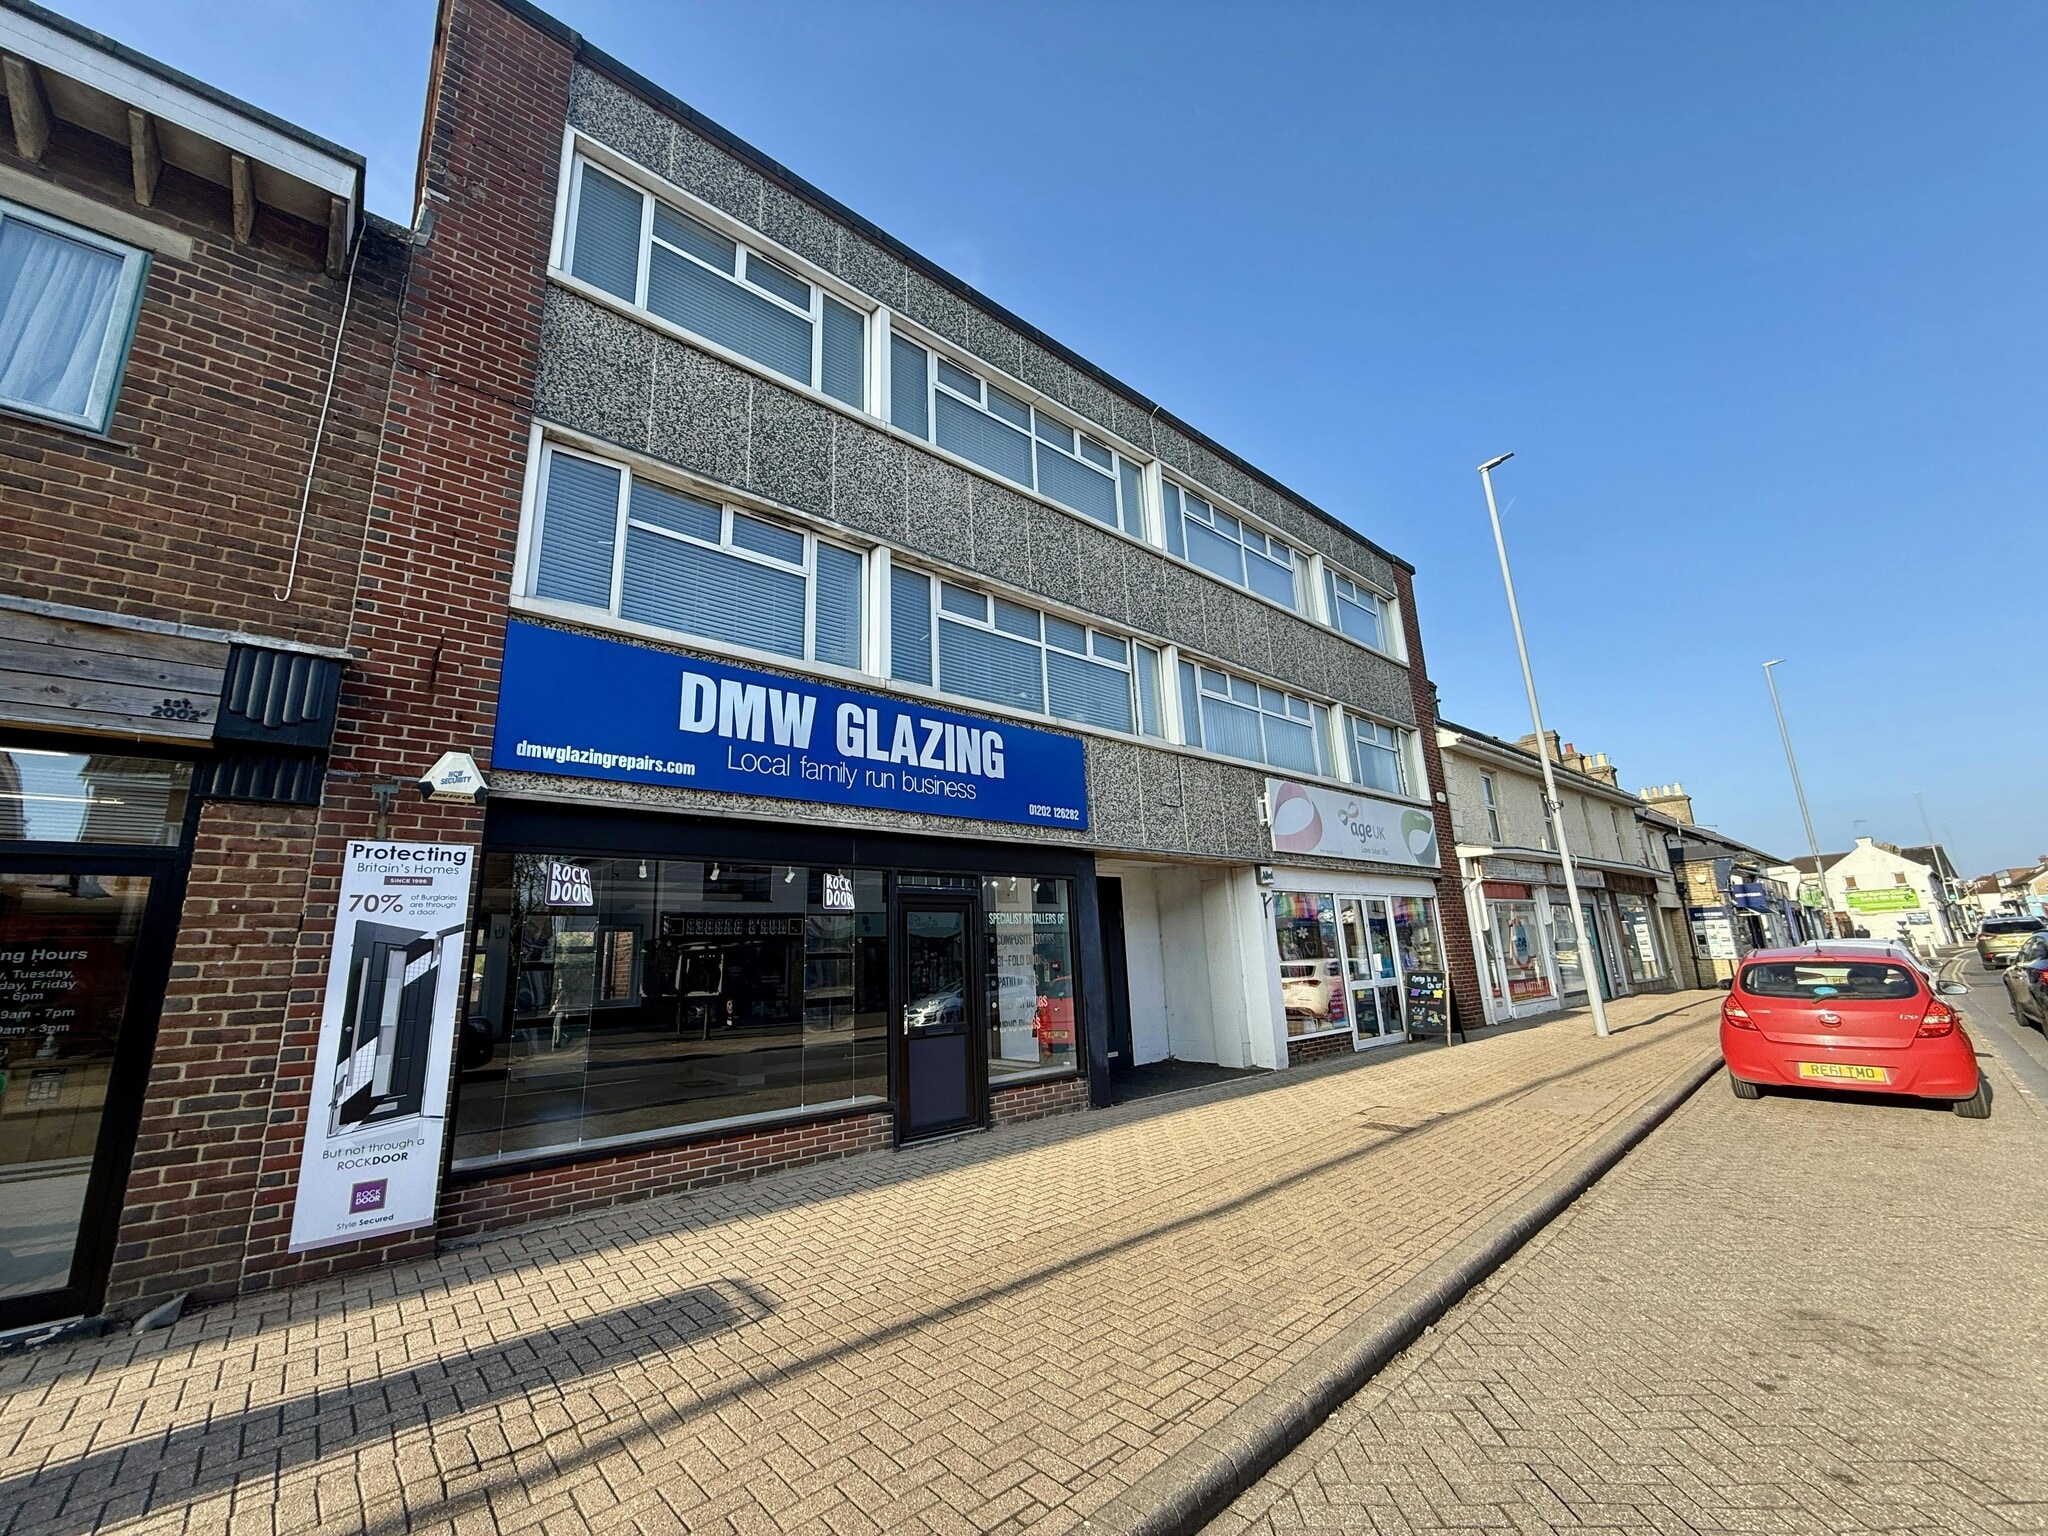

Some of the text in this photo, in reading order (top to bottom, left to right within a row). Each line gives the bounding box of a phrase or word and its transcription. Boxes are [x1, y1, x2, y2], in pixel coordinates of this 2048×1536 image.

[151, 705, 199, 721] 2002
[679, 671, 1005, 779] DMW GLAZING
[516, 740, 696, 776] dmwglazingrepairs.com
[728, 745, 977, 800] Local family run business
[440, 776, 472, 785] SECURITY
[1029, 804, 1079, 820] 01202 126282
[352, 844, 467, 866] Protecting
[357, 862, 459, 875] Britain's Homes
[552, 863, 589, 884] ROCK
[826, 874, 851, 892] ROCK
[550, 880, 591, 902] DOOR
[348, 894, 403, 913] 70%
[421, 894, 458, 904] Burglaries
[826, 889, 853, 907] DOOR
[426, 901, 456, 909] through
[989, 912, 1065, 924] SPECIALIST INSTALLERS OF
[997, 933, 1033, 945] COMPOSITE
[31, 949, 88, 960] Hours
[12, 969, 74, 979] Tuesday,
[0, 980, 77, 992] day, Friday
[12, 992, 44, 1002] 6pm
[0, 1010, 31, 1019] 9am
[45, 1008, 75, 1019] 7pm
[39, 1024, 70, 1034] 3pm
[1846, 1067, 1875, 1078] TMO
[322, 1138, 425, 1159] But not through a
[337, 1152, 408, 1171] ROCKDOOR
[355, 1195, 381, 1205] DOOR
[356, 1188, 381, 1199] ROCK
[336, 1214, 394, 1230] Style Secured
